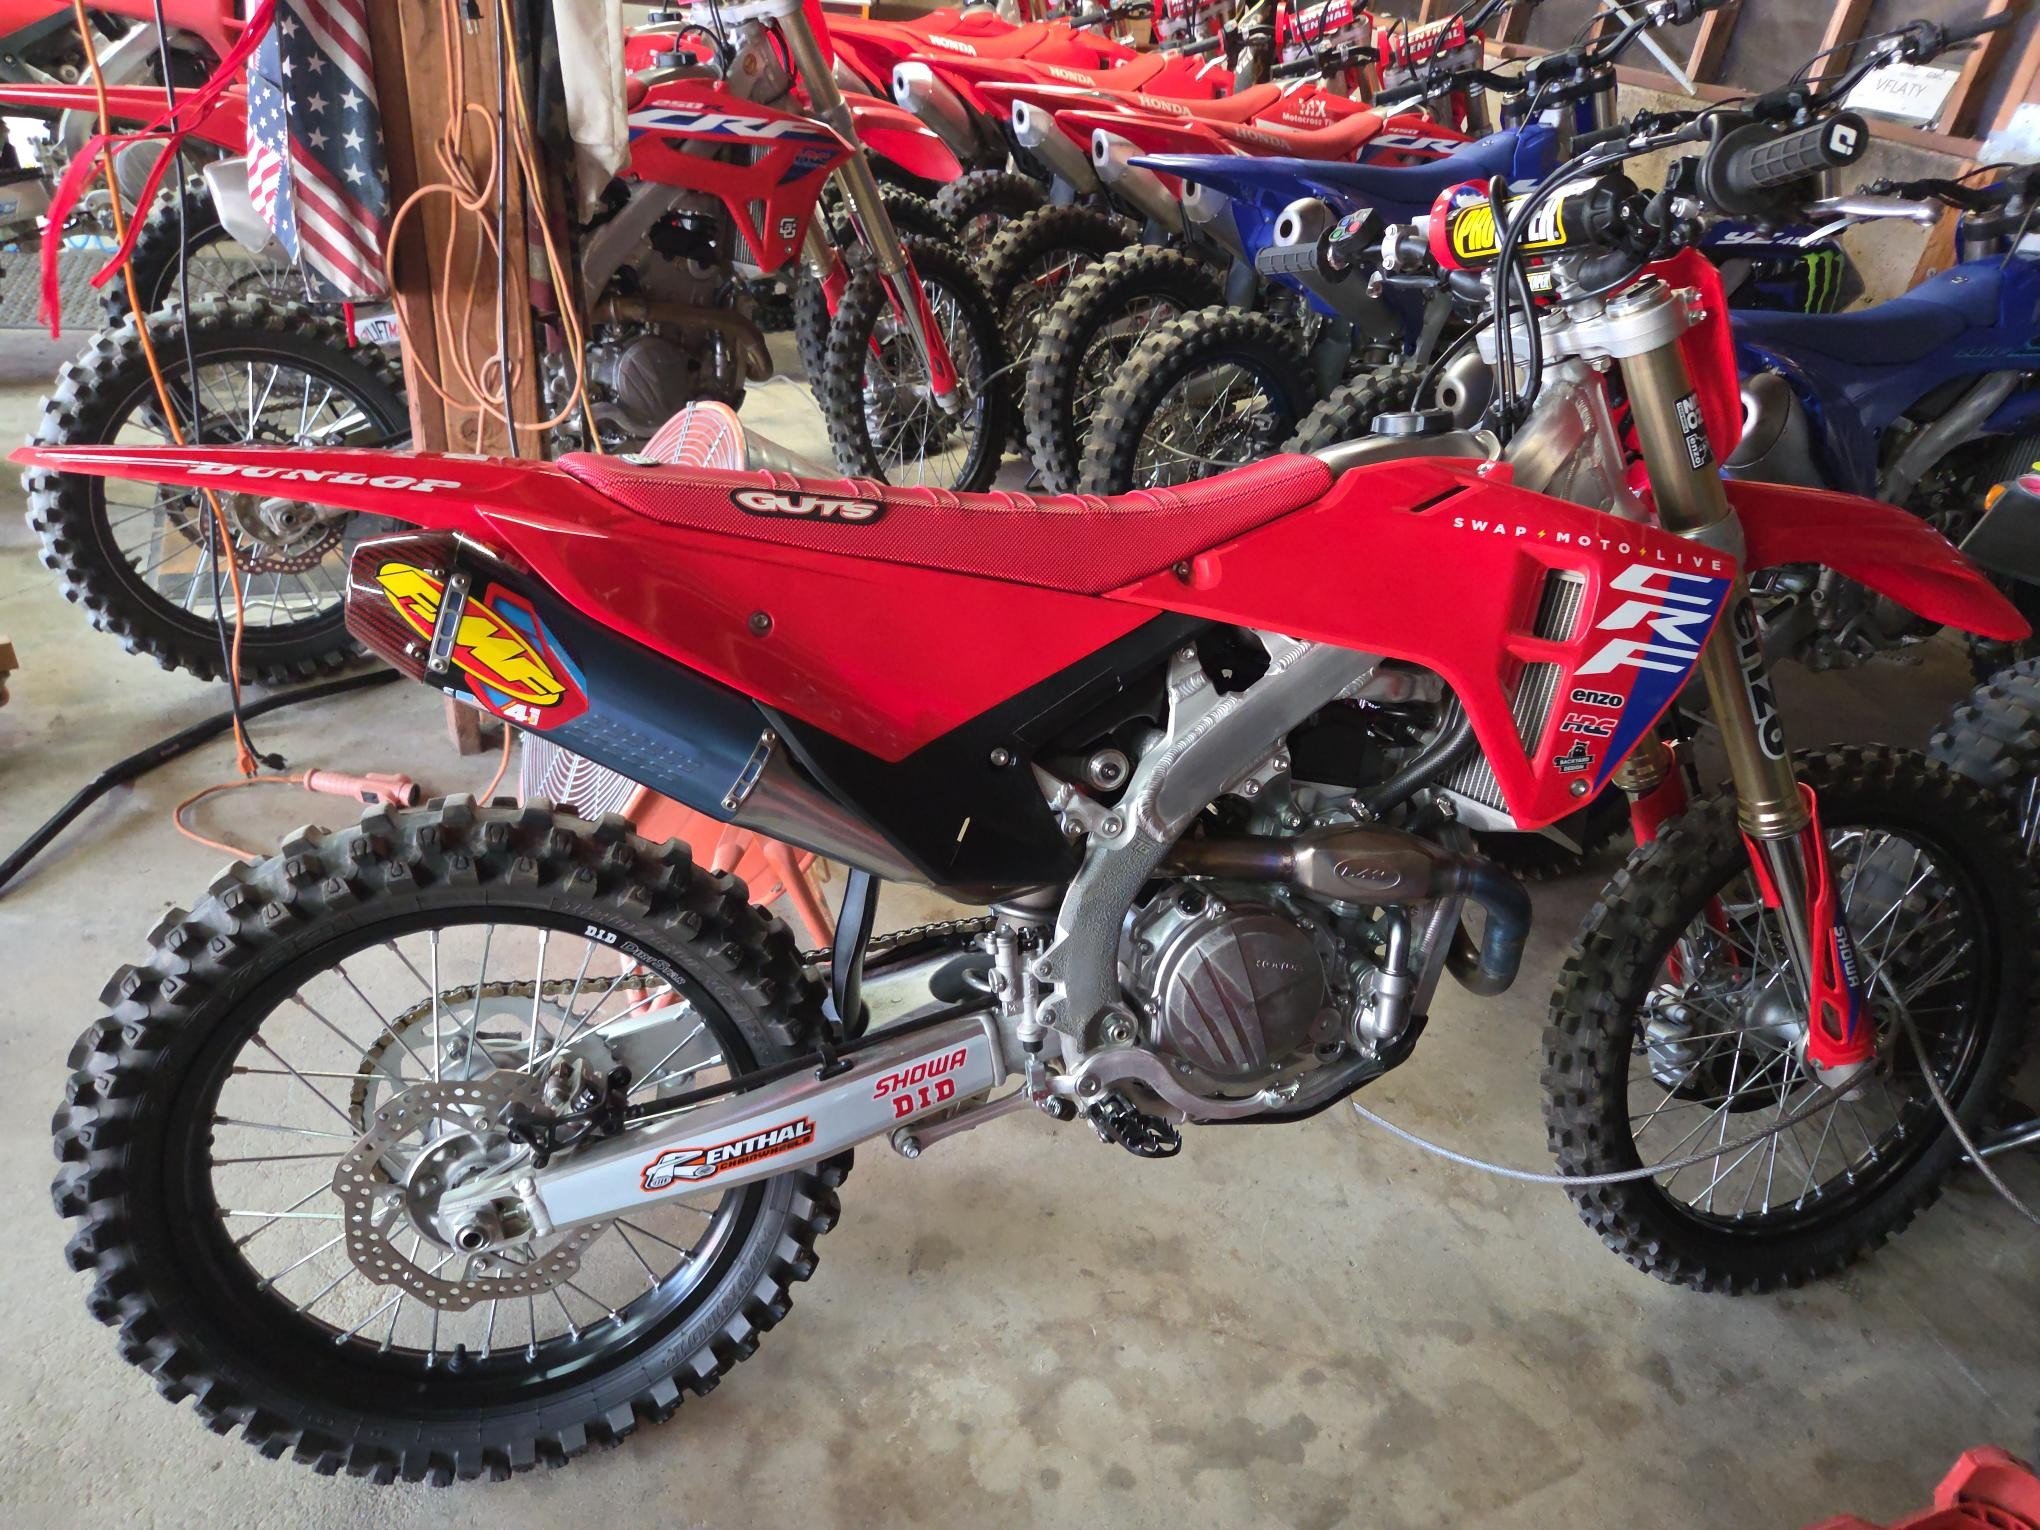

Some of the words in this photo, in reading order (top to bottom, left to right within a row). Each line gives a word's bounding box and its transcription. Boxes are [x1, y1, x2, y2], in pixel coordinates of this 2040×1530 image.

[928, 34, 977, 57] HONDA
[1049, 66, 1096, 87] HONDA
[1138, 94, 1192, 117] HONDA
[628, 109, 821, 138] CRF
[1282, 112, 1322, 126] Motocross
[186, 461, 462, 493] DUNLOP
[737, 491, 878, 520] GUTS
[1453, 516, 1528, 538] SWAP
[1555, 532, 1631, 554] MOTO
[1656, 549, 1721, 572] LIVE
[1571, 689, 1624, 708] enzo
[1560, 713, 1618, 737] HRC
[1833, 926, 1860, 988] SHOWA
[873, 1048, 967, 1100] SHOWA
